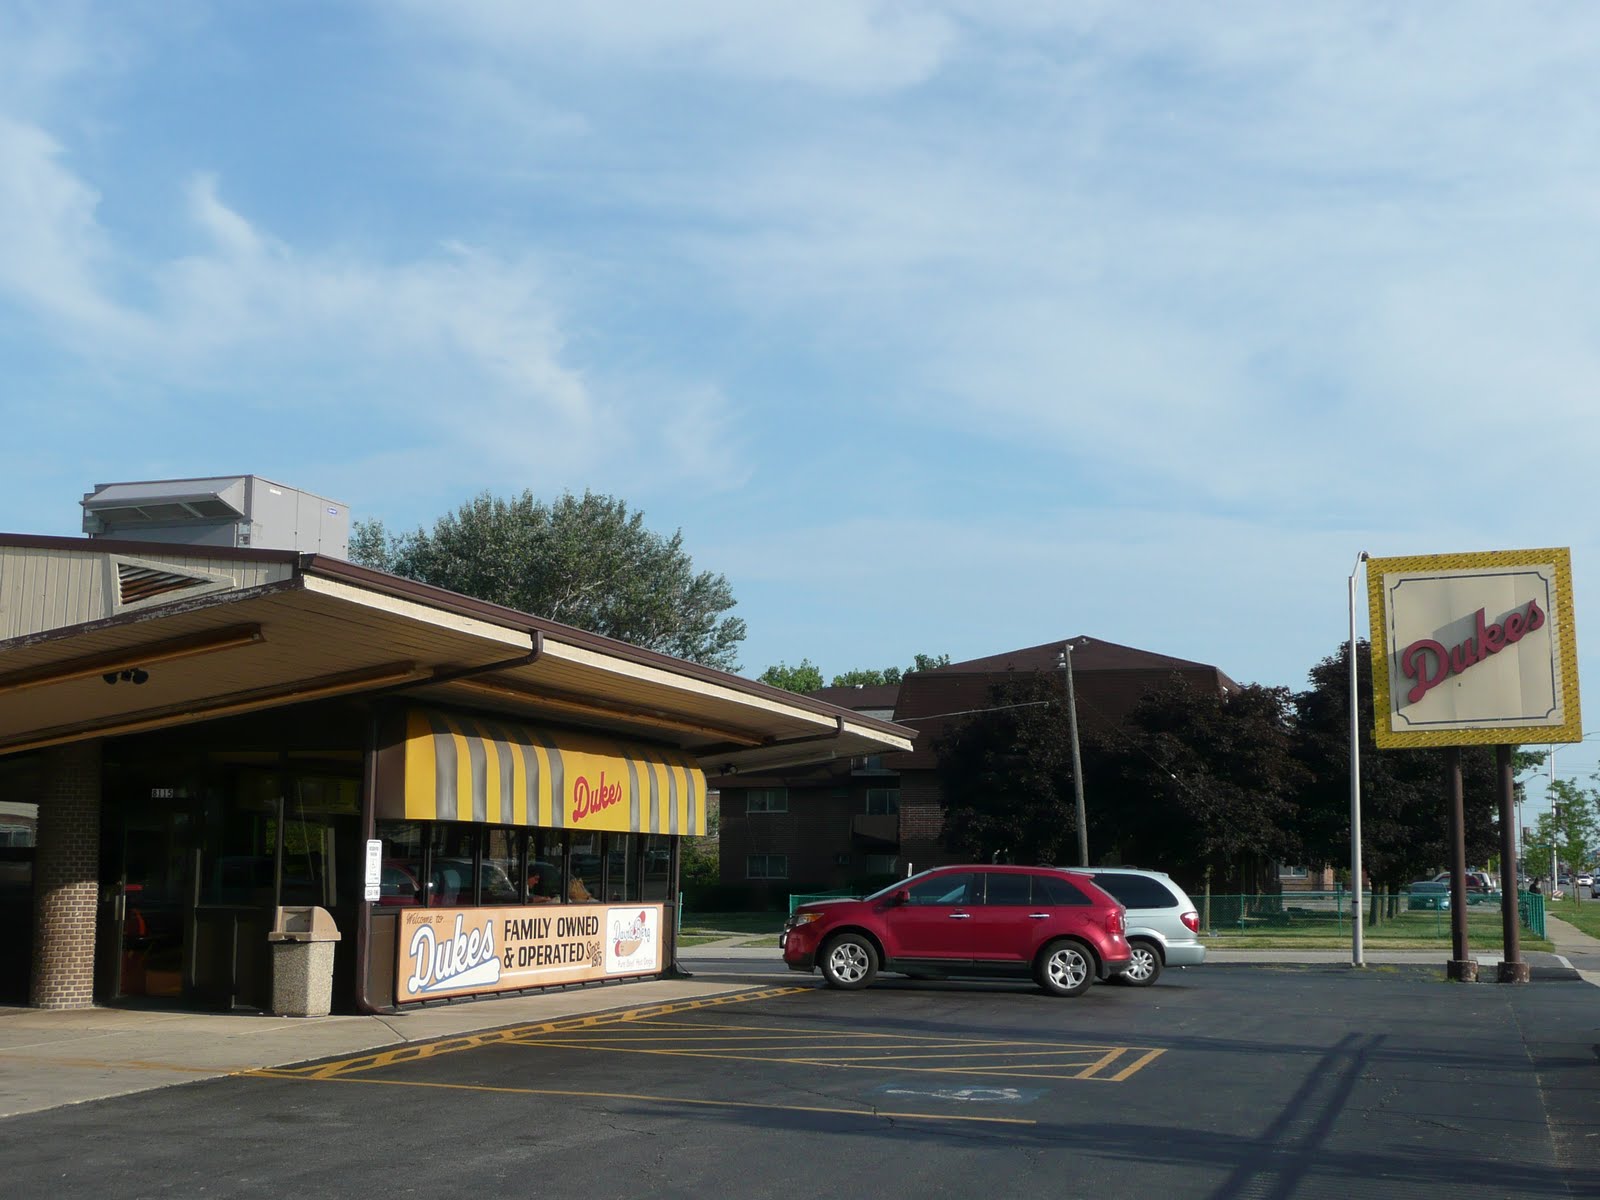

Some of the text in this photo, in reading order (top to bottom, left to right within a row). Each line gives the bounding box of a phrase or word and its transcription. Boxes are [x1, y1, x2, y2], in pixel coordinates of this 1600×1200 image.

[1402, 598, 1545, 703] Dukes
[152, 789, 173, 798] 8115
[573, 771, 622, 823] Dukes
[406, 912, 433, 925] Welcome
[504, 916, 599, 941] FAMILY OWNED
[408, 914, 496, 994] Dukes
[503, 942, 584, 968] & OPERATED
[586, 941, 600, 960] Since
